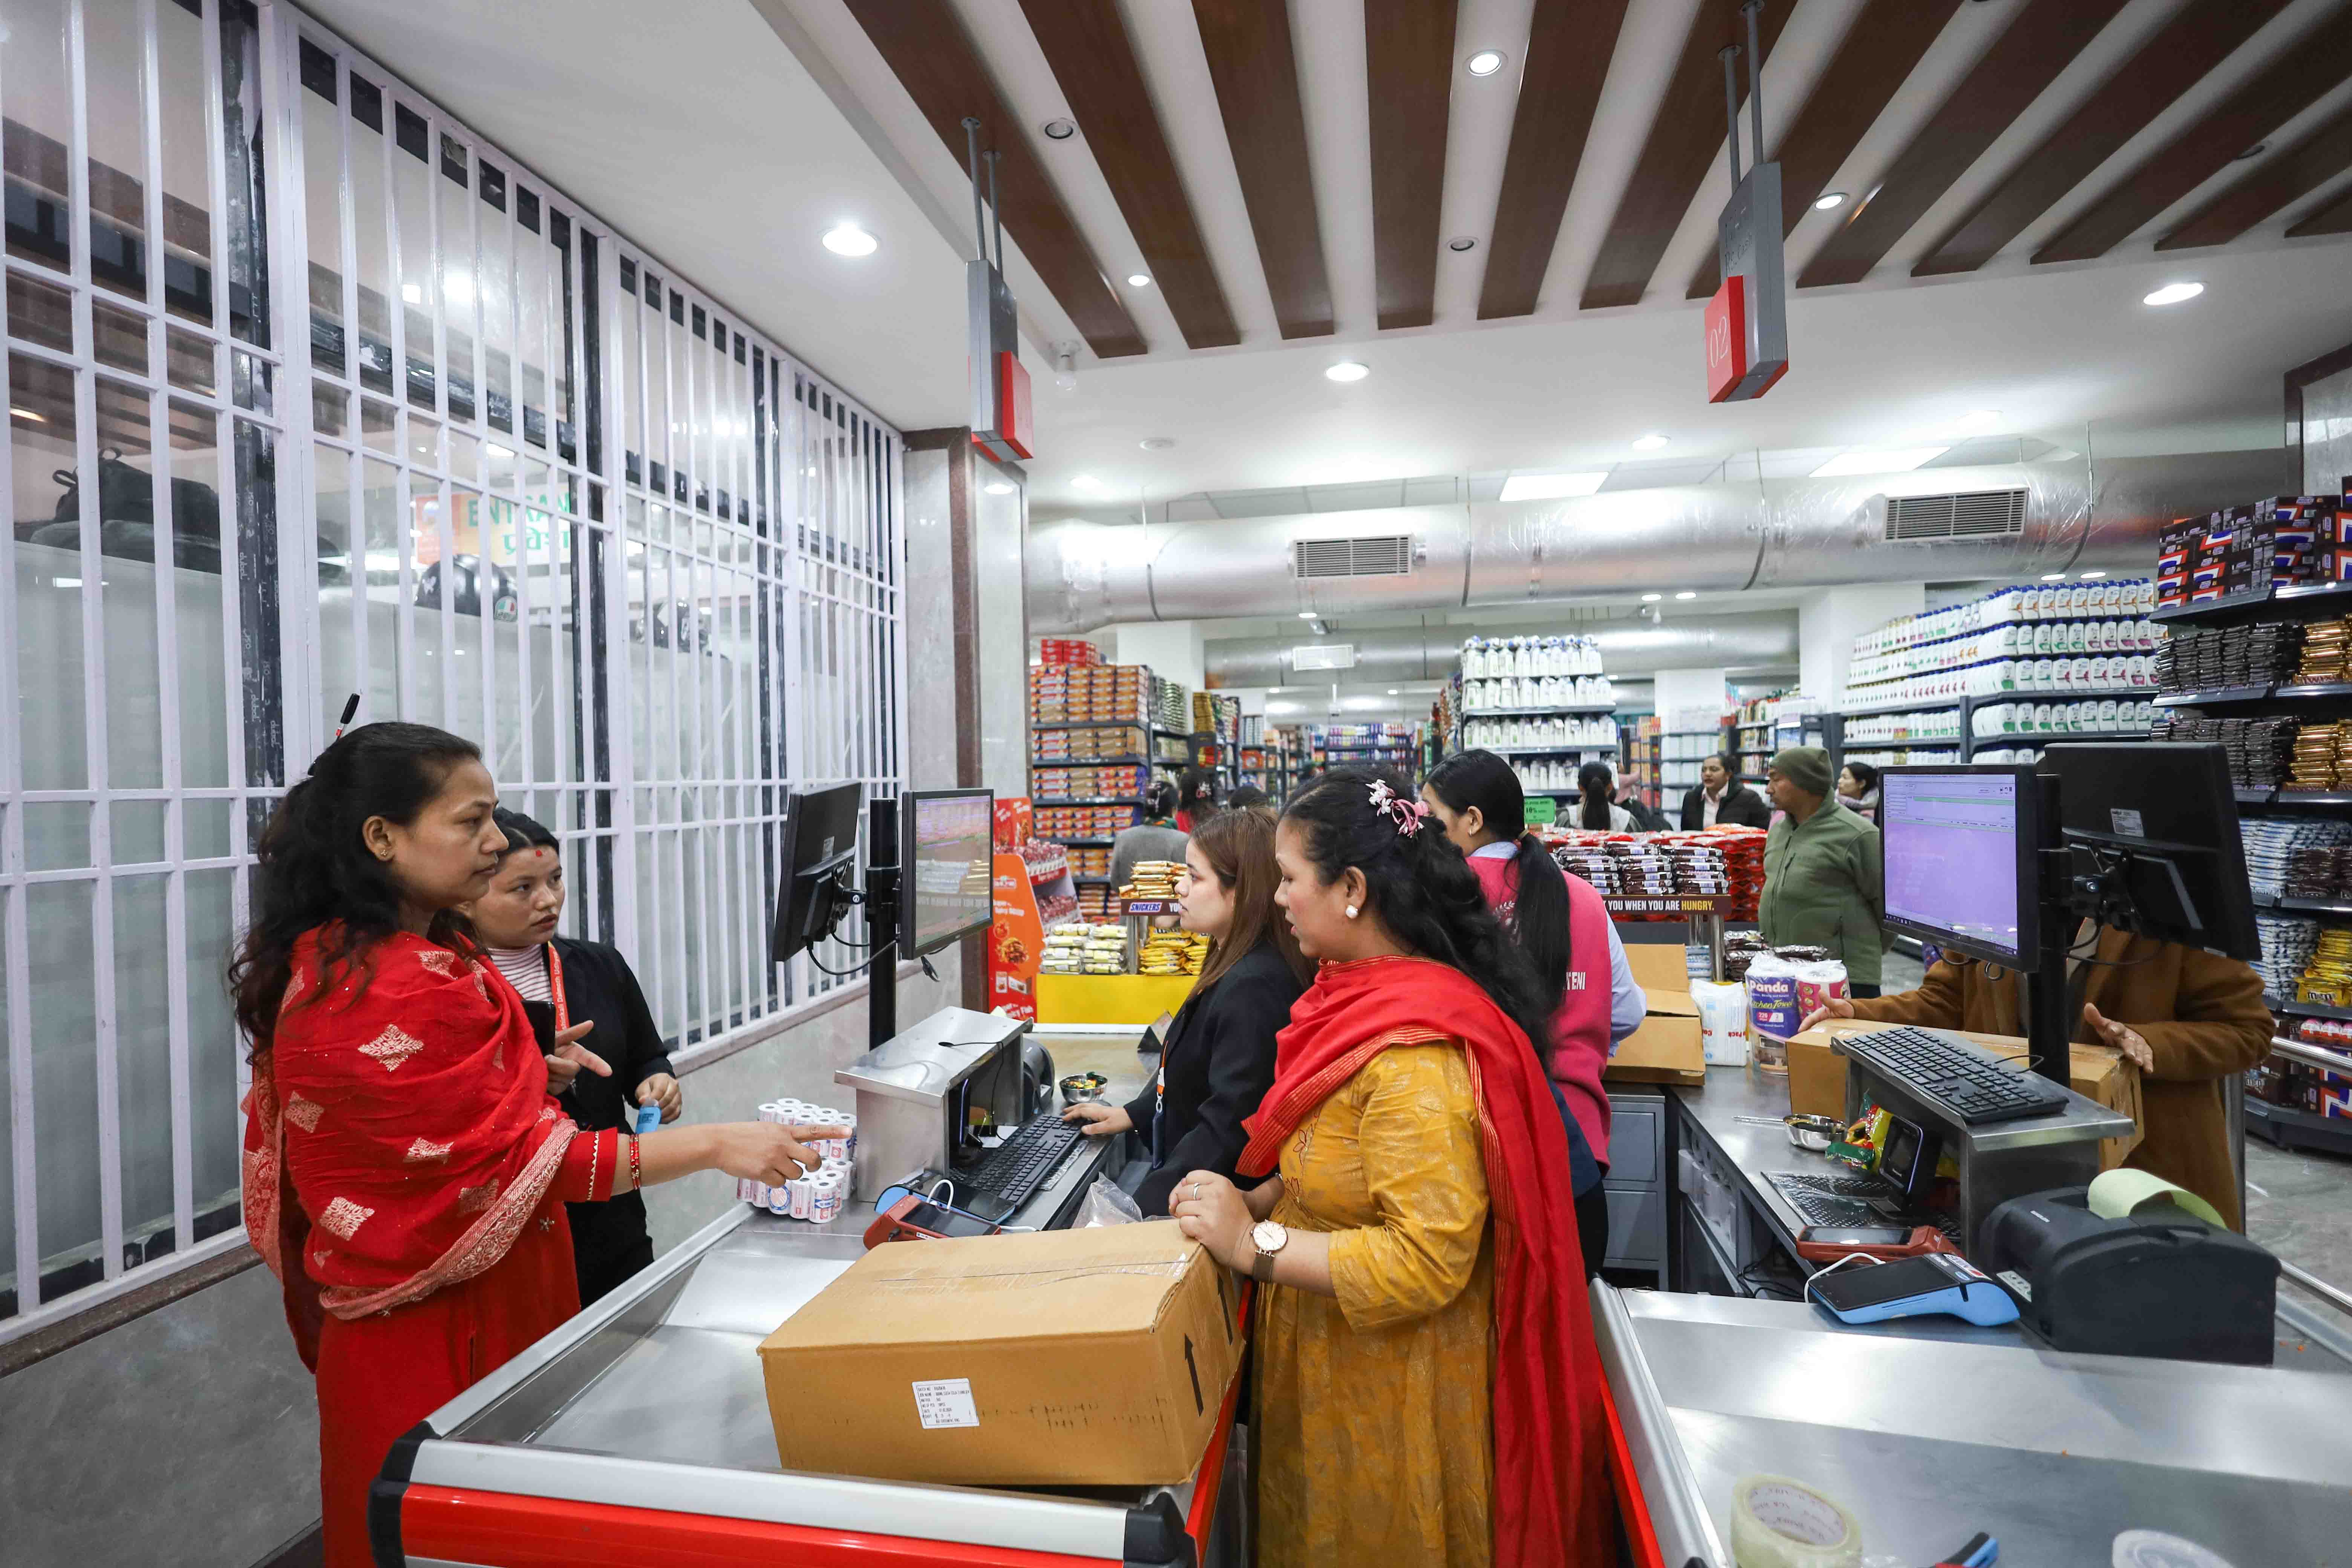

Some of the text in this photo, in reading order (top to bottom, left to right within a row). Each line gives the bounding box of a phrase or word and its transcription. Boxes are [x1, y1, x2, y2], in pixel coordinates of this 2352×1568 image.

[1710, 316, 1728, 368] 02
[469, 492, 571, 527] ENTRAN
[1608, 900, 1623, 911] YOU
[1625, 900, 1646, 911] WHEN
[1648, 900, 1663, 911] YOU
[1665, 900, 1680, 911] ARE
[1681, 900, 1714, 911] HUNGRY.
[1566, 971, 1586, 990] TENI
[1750, 980, 1788, 992] Panda
